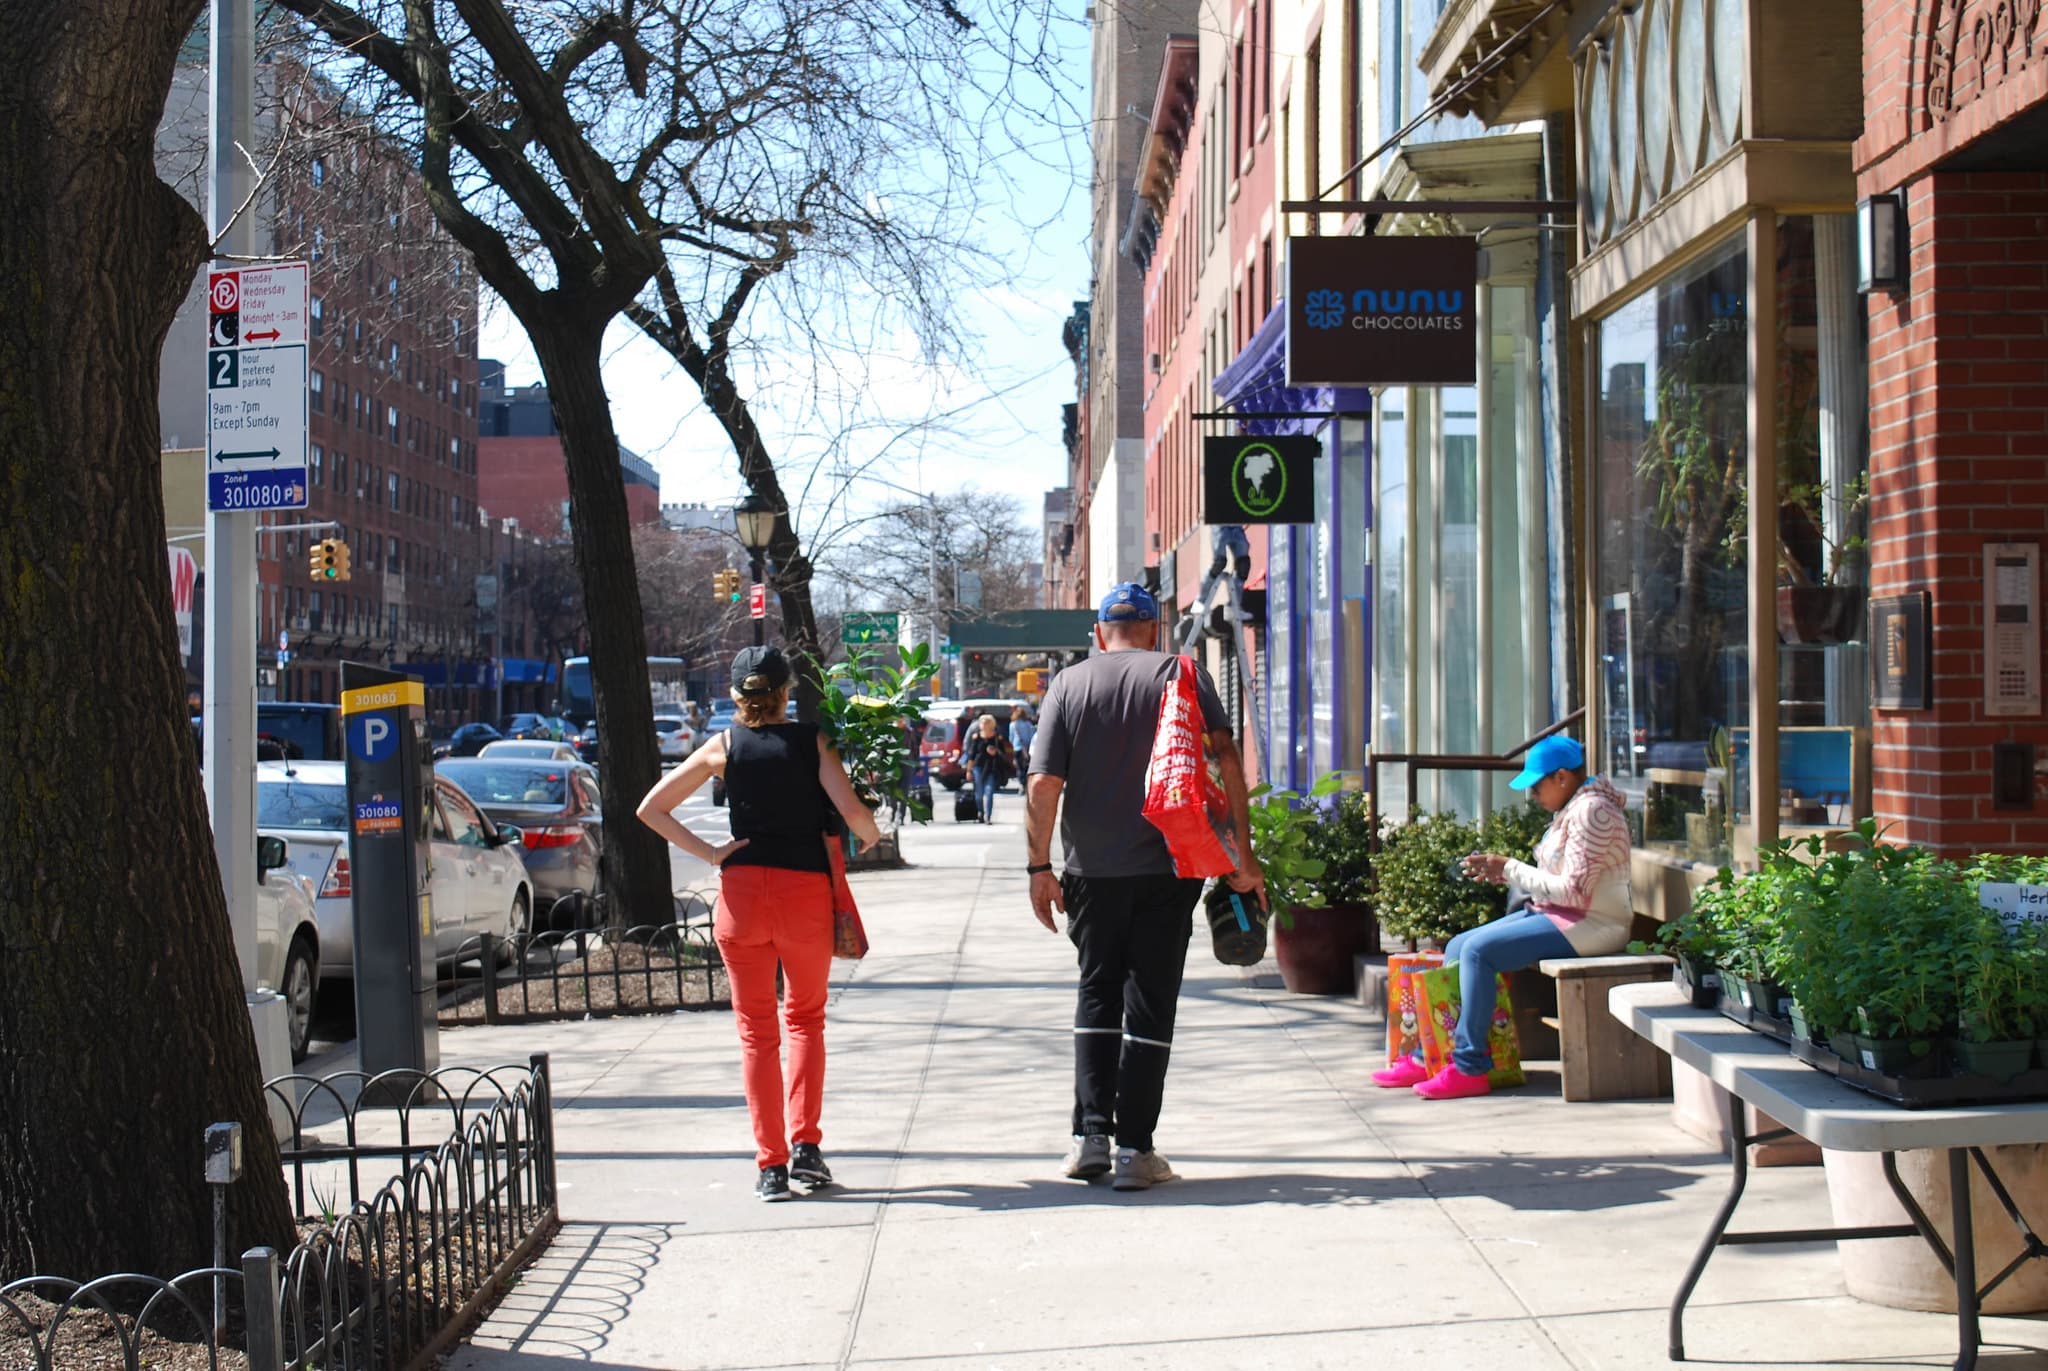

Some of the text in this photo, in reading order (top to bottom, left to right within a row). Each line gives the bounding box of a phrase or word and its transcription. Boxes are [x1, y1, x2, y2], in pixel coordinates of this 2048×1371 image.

[242, 274, 272, 284] Monday
[242, 285, 286, 296] Wednesday
[242, 299, 265, 309] Friday
[1352, 289, 1463, 313] nunu
[242, 312, 274, 324] Midnight
[281, 310, 298, 321] 3am
[1351, 316, 1463, 330] CHOCOLATES
[242, 355, 260, 364] hour
[216, 353, 231, 386] 2
[242, 365, 275, 376] metered
[242, 377, 271, 389] parking
[213, 402, 232, 414] 9am
[241, 401, 260, 413] 7pm
[213, 415, 280, 430] Except Sunday
[223, 484, 281, 507] 301080
[355, 693, 397, 706] 301080
[365, 718, 389, 756] P
[359, 806, 398, 818] 301080
